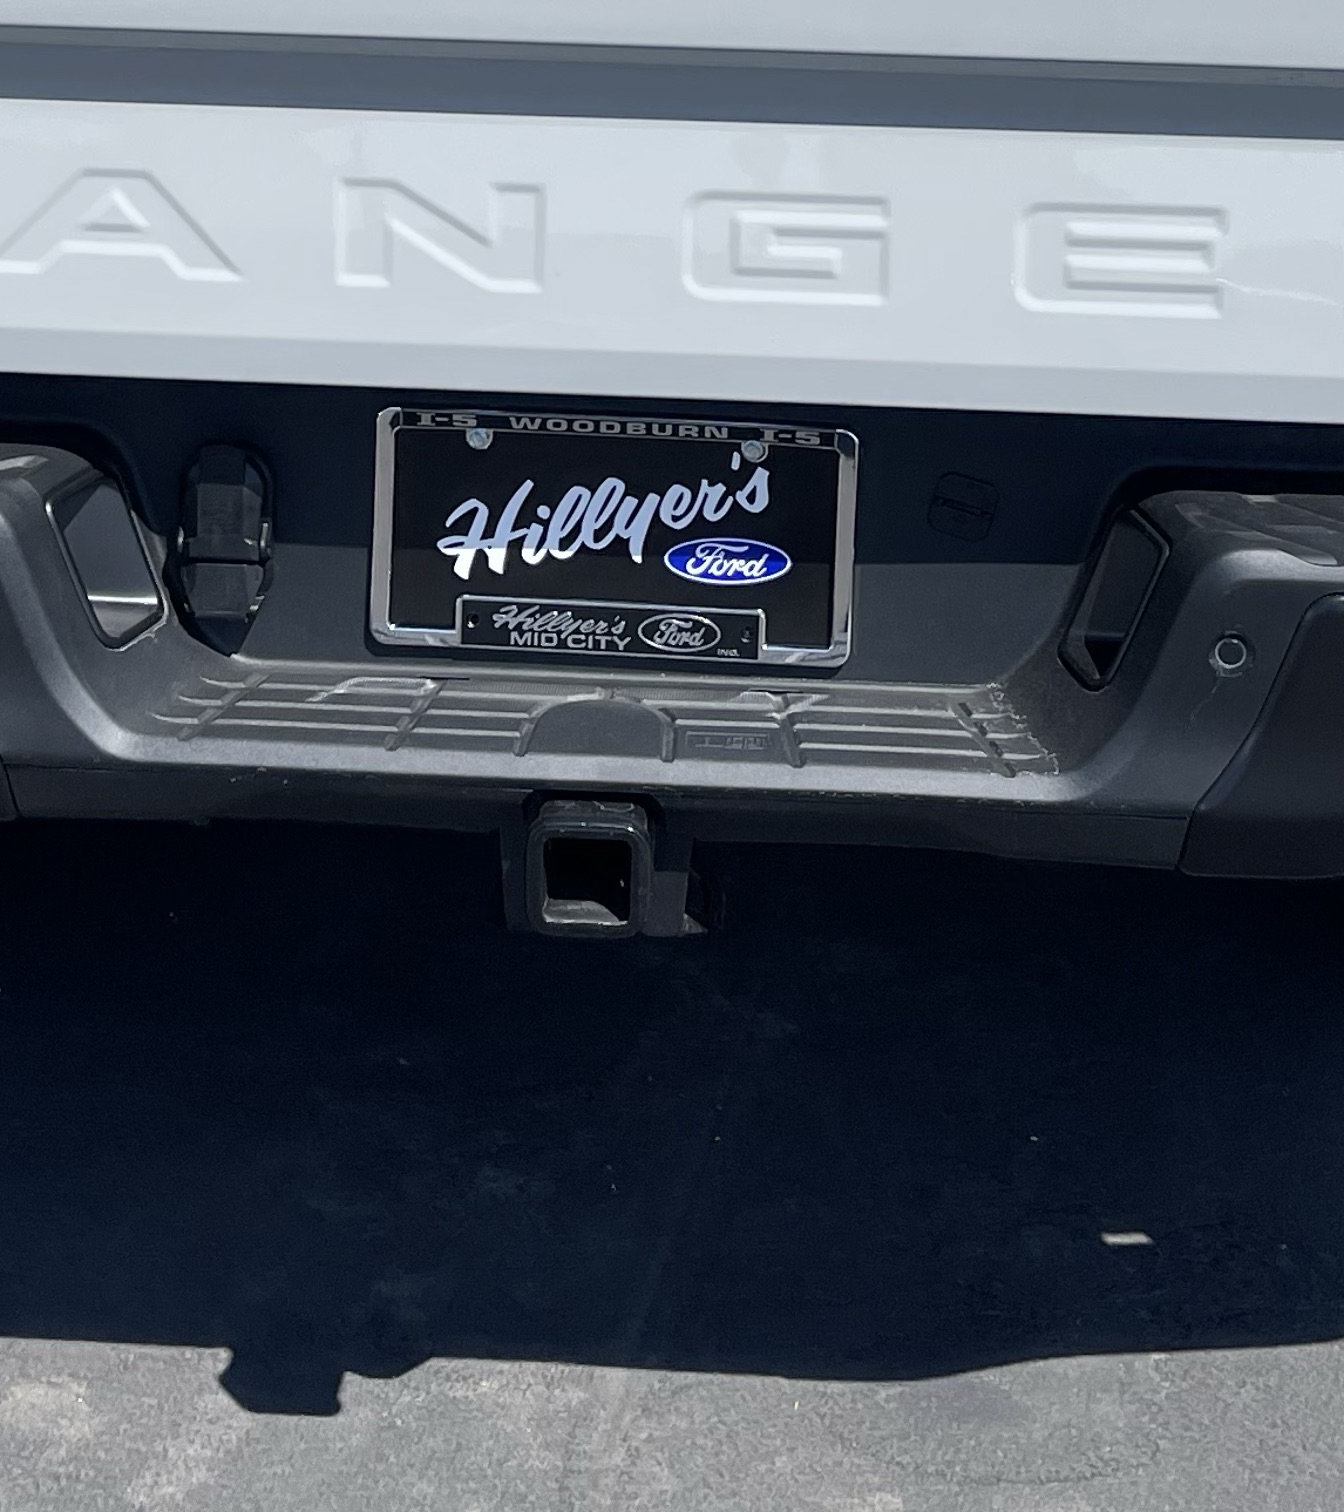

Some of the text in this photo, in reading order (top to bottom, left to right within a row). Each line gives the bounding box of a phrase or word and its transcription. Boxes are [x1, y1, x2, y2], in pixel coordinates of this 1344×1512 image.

[415, 411, 821, 445] I-5 WOODBURN I-5
[437, 451, 770, 580] Hillyer's
[685, 543, 769, 578] Ford
[492, 604, 706, 647] Hillyer's Ford
[509, 630, 632, 651] MID CITY
